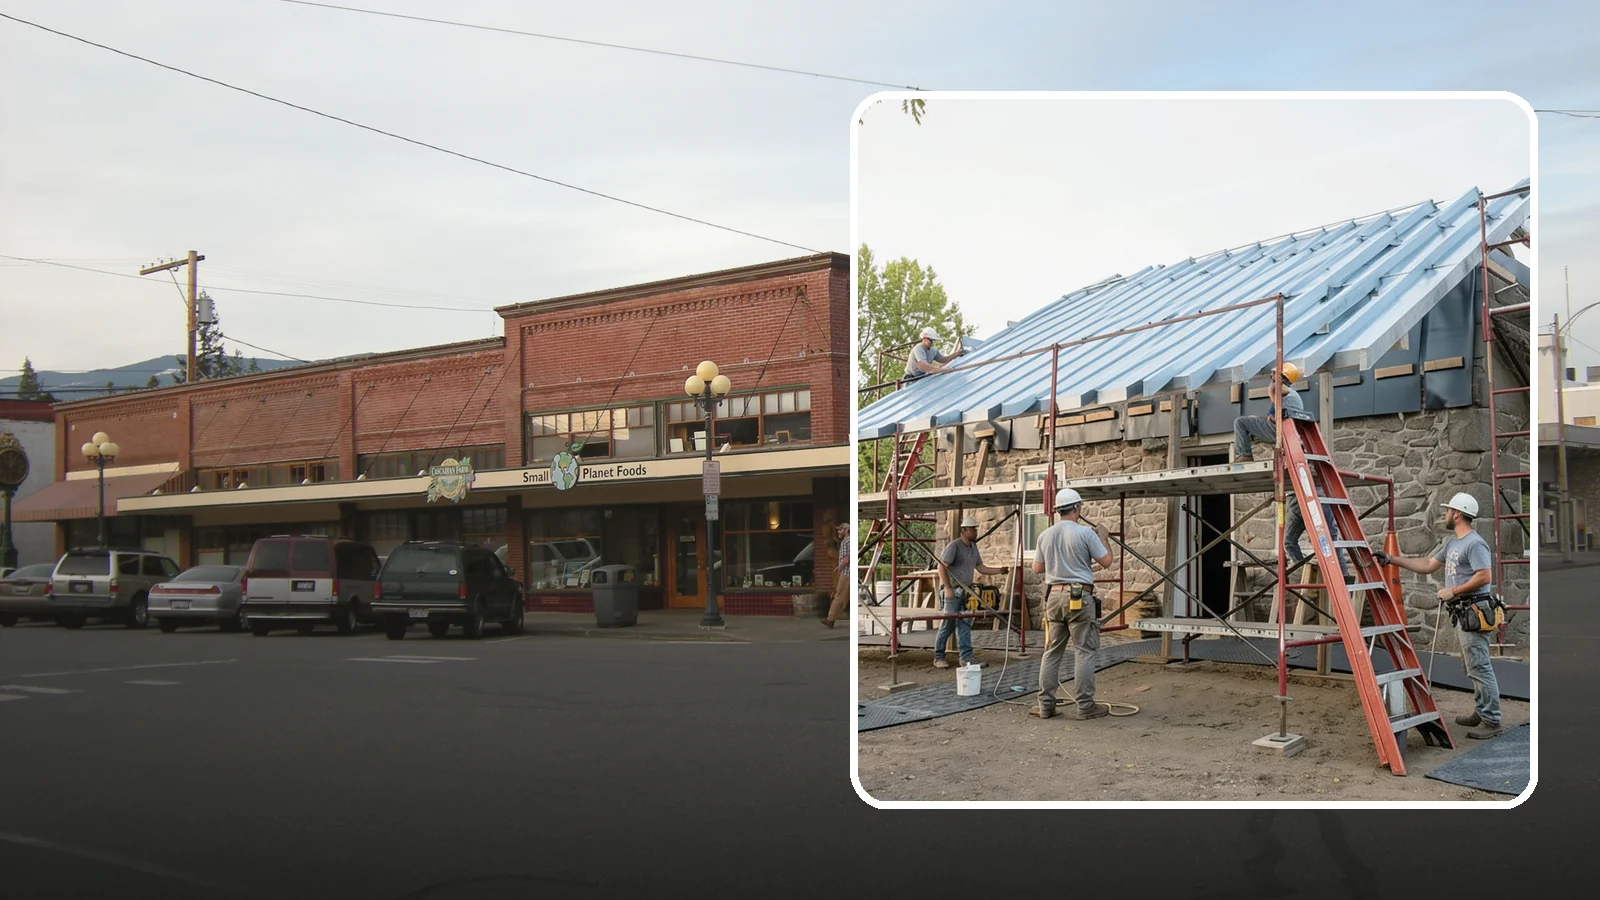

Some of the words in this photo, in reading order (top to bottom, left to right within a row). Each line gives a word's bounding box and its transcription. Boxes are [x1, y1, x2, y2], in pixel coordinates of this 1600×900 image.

[522, 471, 549, 483] Small
[582, 467, 614, 479] Planet
[616, 464, 647, 477] Foods
